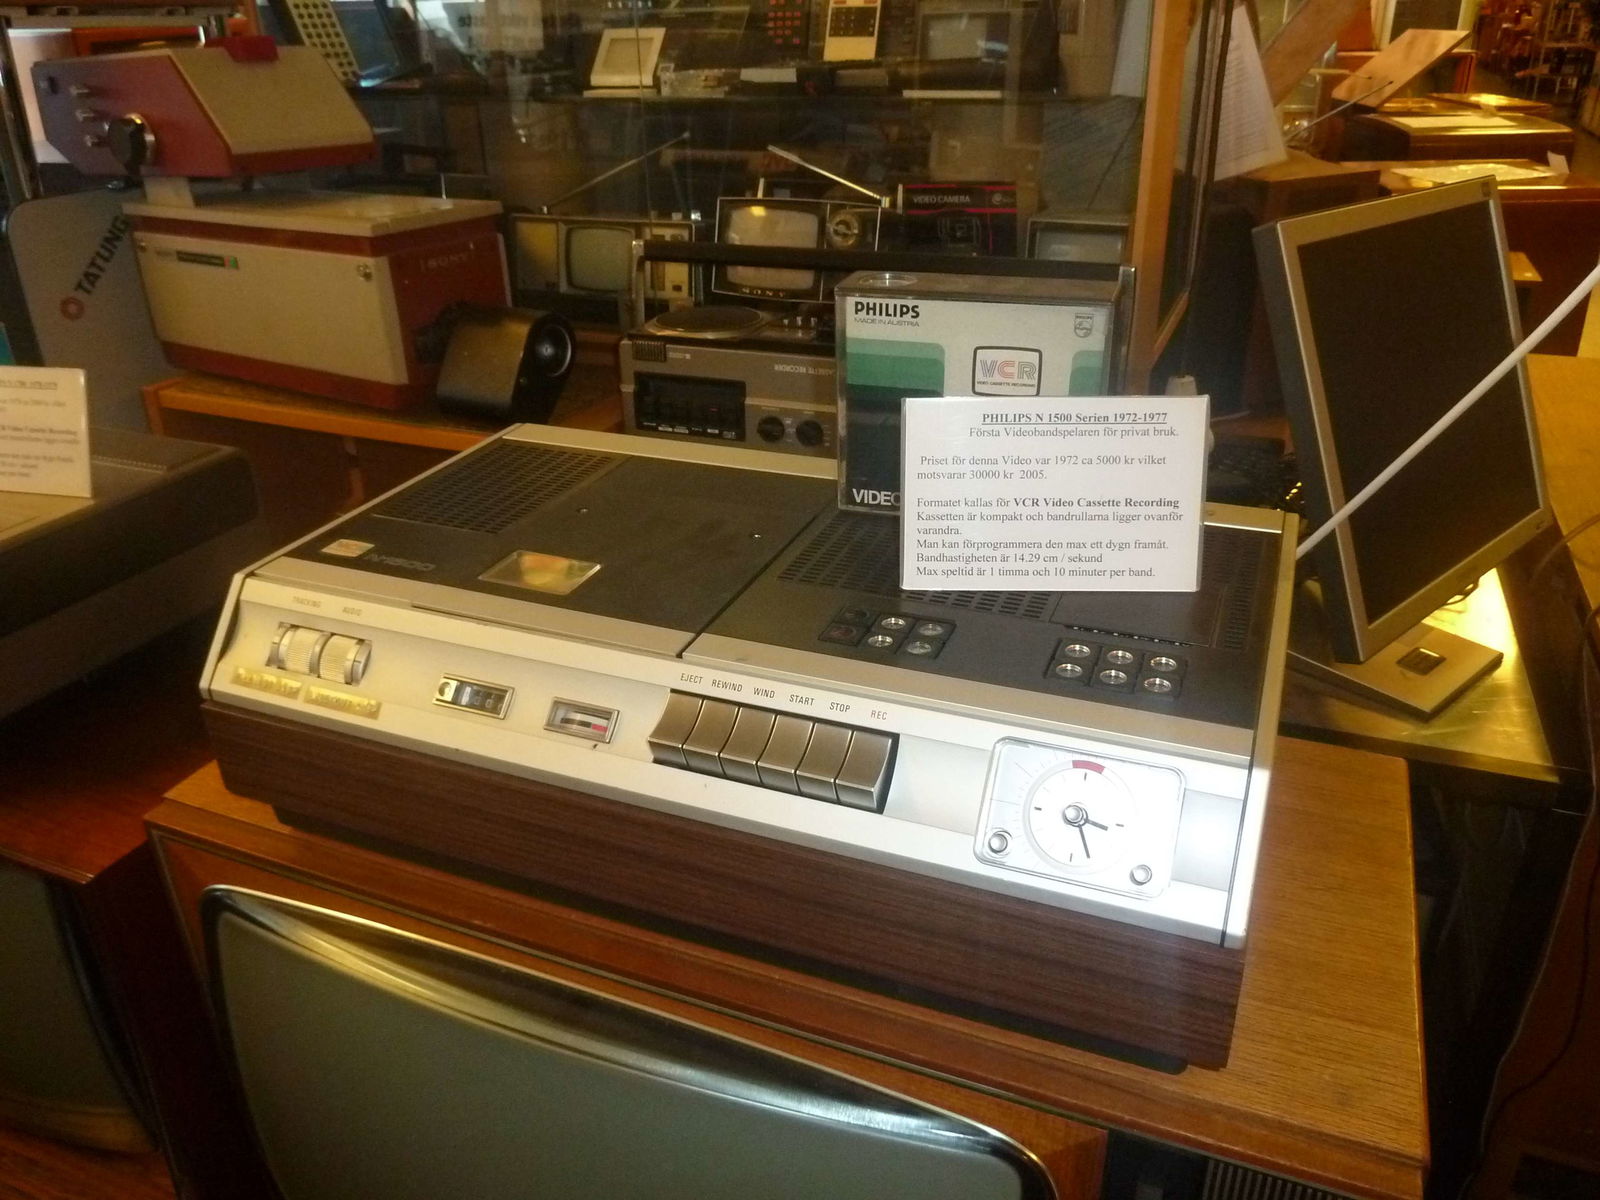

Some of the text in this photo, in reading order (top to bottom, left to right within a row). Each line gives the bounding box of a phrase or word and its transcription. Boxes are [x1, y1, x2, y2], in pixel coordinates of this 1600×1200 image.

[939, 195, 970, 203] CAMERA
[74, 214, 131, 294] TATUNG
[742, 288, 785, 297] SONY
[854, 301, 920, 318] PHILIPS
[887, 319, 920, 327] AUSTRIA
[980, 360, 1037, 380] VCR
[982, 413, 1167, 425] PHILIPS N 1500 Serien 1972-1977
[970, 426, 1178, 439] Första Videobandspelaren för privat bruk.
[921, 456, 947, 465] Priset
[952, 456, 966, 465] för
[969, 456, 998, 465] denna
[1002, 456, 1031, 465] Video
[1056, 456, 1078, 464] 1972
[1096, 455, 1121, 465] 5000
[1124, 455, 1135, 464] kr
[1138, 455, 1166, 464] vilket
[970, 470, 1000, 479] 30000
[1004, 470, 1014, 479] kr
[1020, 469, 1047, 479] 2005.
[918, 498, 1179, 509] Formatet kallas för VCR Video Cassette Recording
[917, 512, 964, 521] Kassetten
[980, 512, 1022, 523] kompakt
[1026, 512, 1043, 521] och
[1047, 512, 1109, 521] bandrullarna
[1113, 512, 1141, 523] ligger
[1144, 512, 1183, 521] ovanför
[917, 526, 962, 535] varandra.
[917, 539, 938, 548] Man
[942, 539, 959, 548] kan
[963, 539, 1042, 551] förprogrammera
[1045, 540, 1063, 548] den
[1090, 541, 1103, 549] ett
[1106, 539, 1130, 551] dygn
[917, 553, 997, 564] Bandhastigheten
[1000, 554, 1010, 562] är
[1015, 553, 1040, 562] 14.29
[1068, 553, 1102, 562] sekund
[917, 567, 938, 576] Max
[941, 567, 973, 578] speltid
[977, 568, 986, 576] är
[999, 567, 1029, 576] timma
[1032, 567, 1050, 576] och
[1055, 567, 1065, 576] 10
[1069, 567, 1107, 576] minuter
[1110, 570, 1126, 579] per
[1129, 568, 1155, 576] band.
[680, 672, 887, 721] EJECT REWIND WIND START STOP REC
